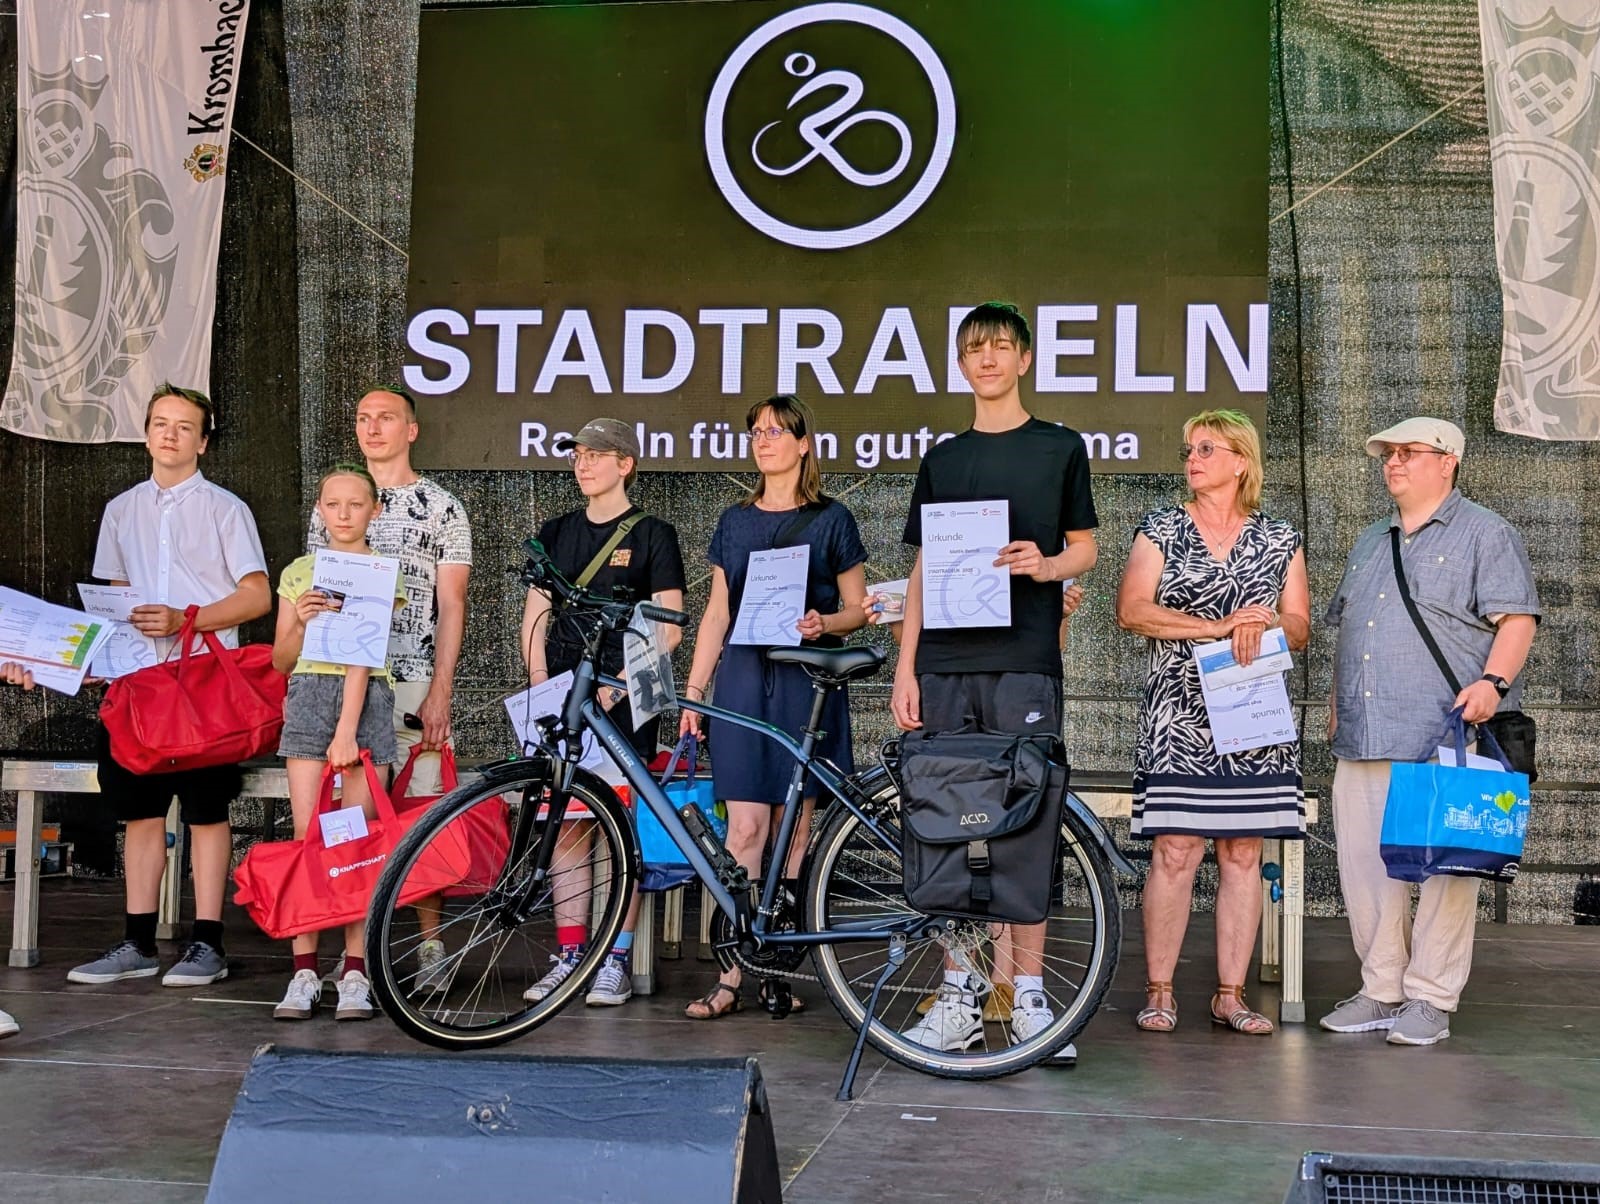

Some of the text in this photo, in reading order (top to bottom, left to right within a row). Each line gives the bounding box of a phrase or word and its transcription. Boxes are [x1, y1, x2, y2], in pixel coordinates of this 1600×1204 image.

[187, 0, 245, 135] Krombac
[520, 422, 674, 458] Raln
[928, 531, 964, 542] Urkunde
[319, 575, 354, 588] Urkunde
[750, 573, 778, 582] Urkunde
[1250, 707, 1286, 720] Urkunde
[340, 853, 387, 873] KNAPPSCHAFT
